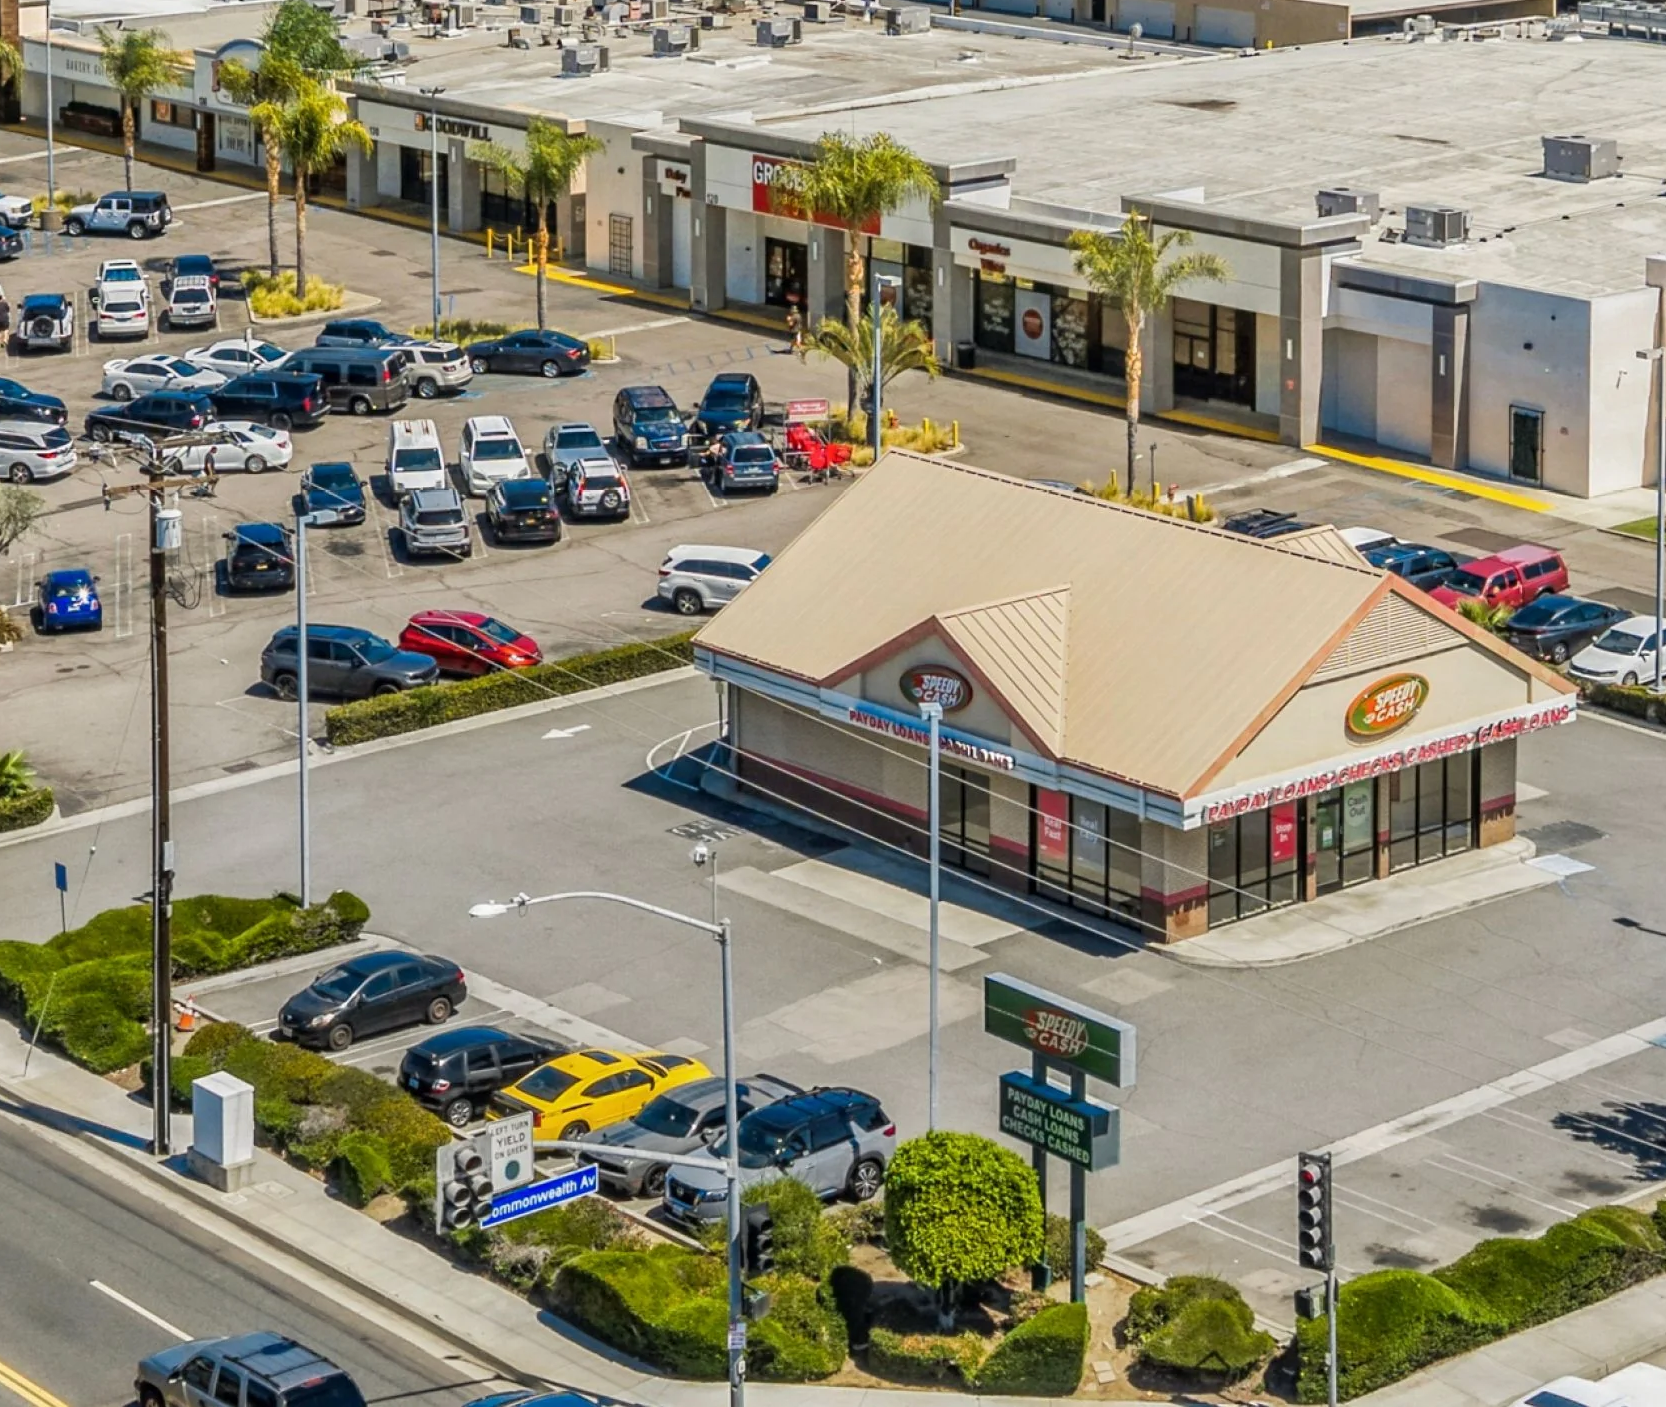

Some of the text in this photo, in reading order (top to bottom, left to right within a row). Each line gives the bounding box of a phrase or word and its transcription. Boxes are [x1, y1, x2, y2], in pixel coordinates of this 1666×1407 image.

[426, 116, 492, 142] GOODWILL
[921, 673, 961, 695] SPEEDY
[1374, 677, 1418, 712] SPEEDY
[848, 708, 890, 733] PAYDAY
[893, 721, 930, 745] LOANS
[1208, 705, 1570, 822] PAYDAY LOANS CHECKS CASHED CASH LOANS
[1347, 794, 1368, 807] Cash
[1349, 806, 1366, 818] Out
[1035, 1010, 1086, 1040] SPEEDY
[1007, 1087, 1086, 1131] PAYDAY LOANS
[511, 1120, 529, 1131] TURN
[1002, 1115, 1091, 1164] CHECKS CASHED
[1013, 1105, 1079, 1144] CASH LOANS
[494, 1145, 529, 1160] ON GREEN
[496, 1132, 526, 1148] YIELD
[492, 1174, 596, 1218] ommonwealth Av
